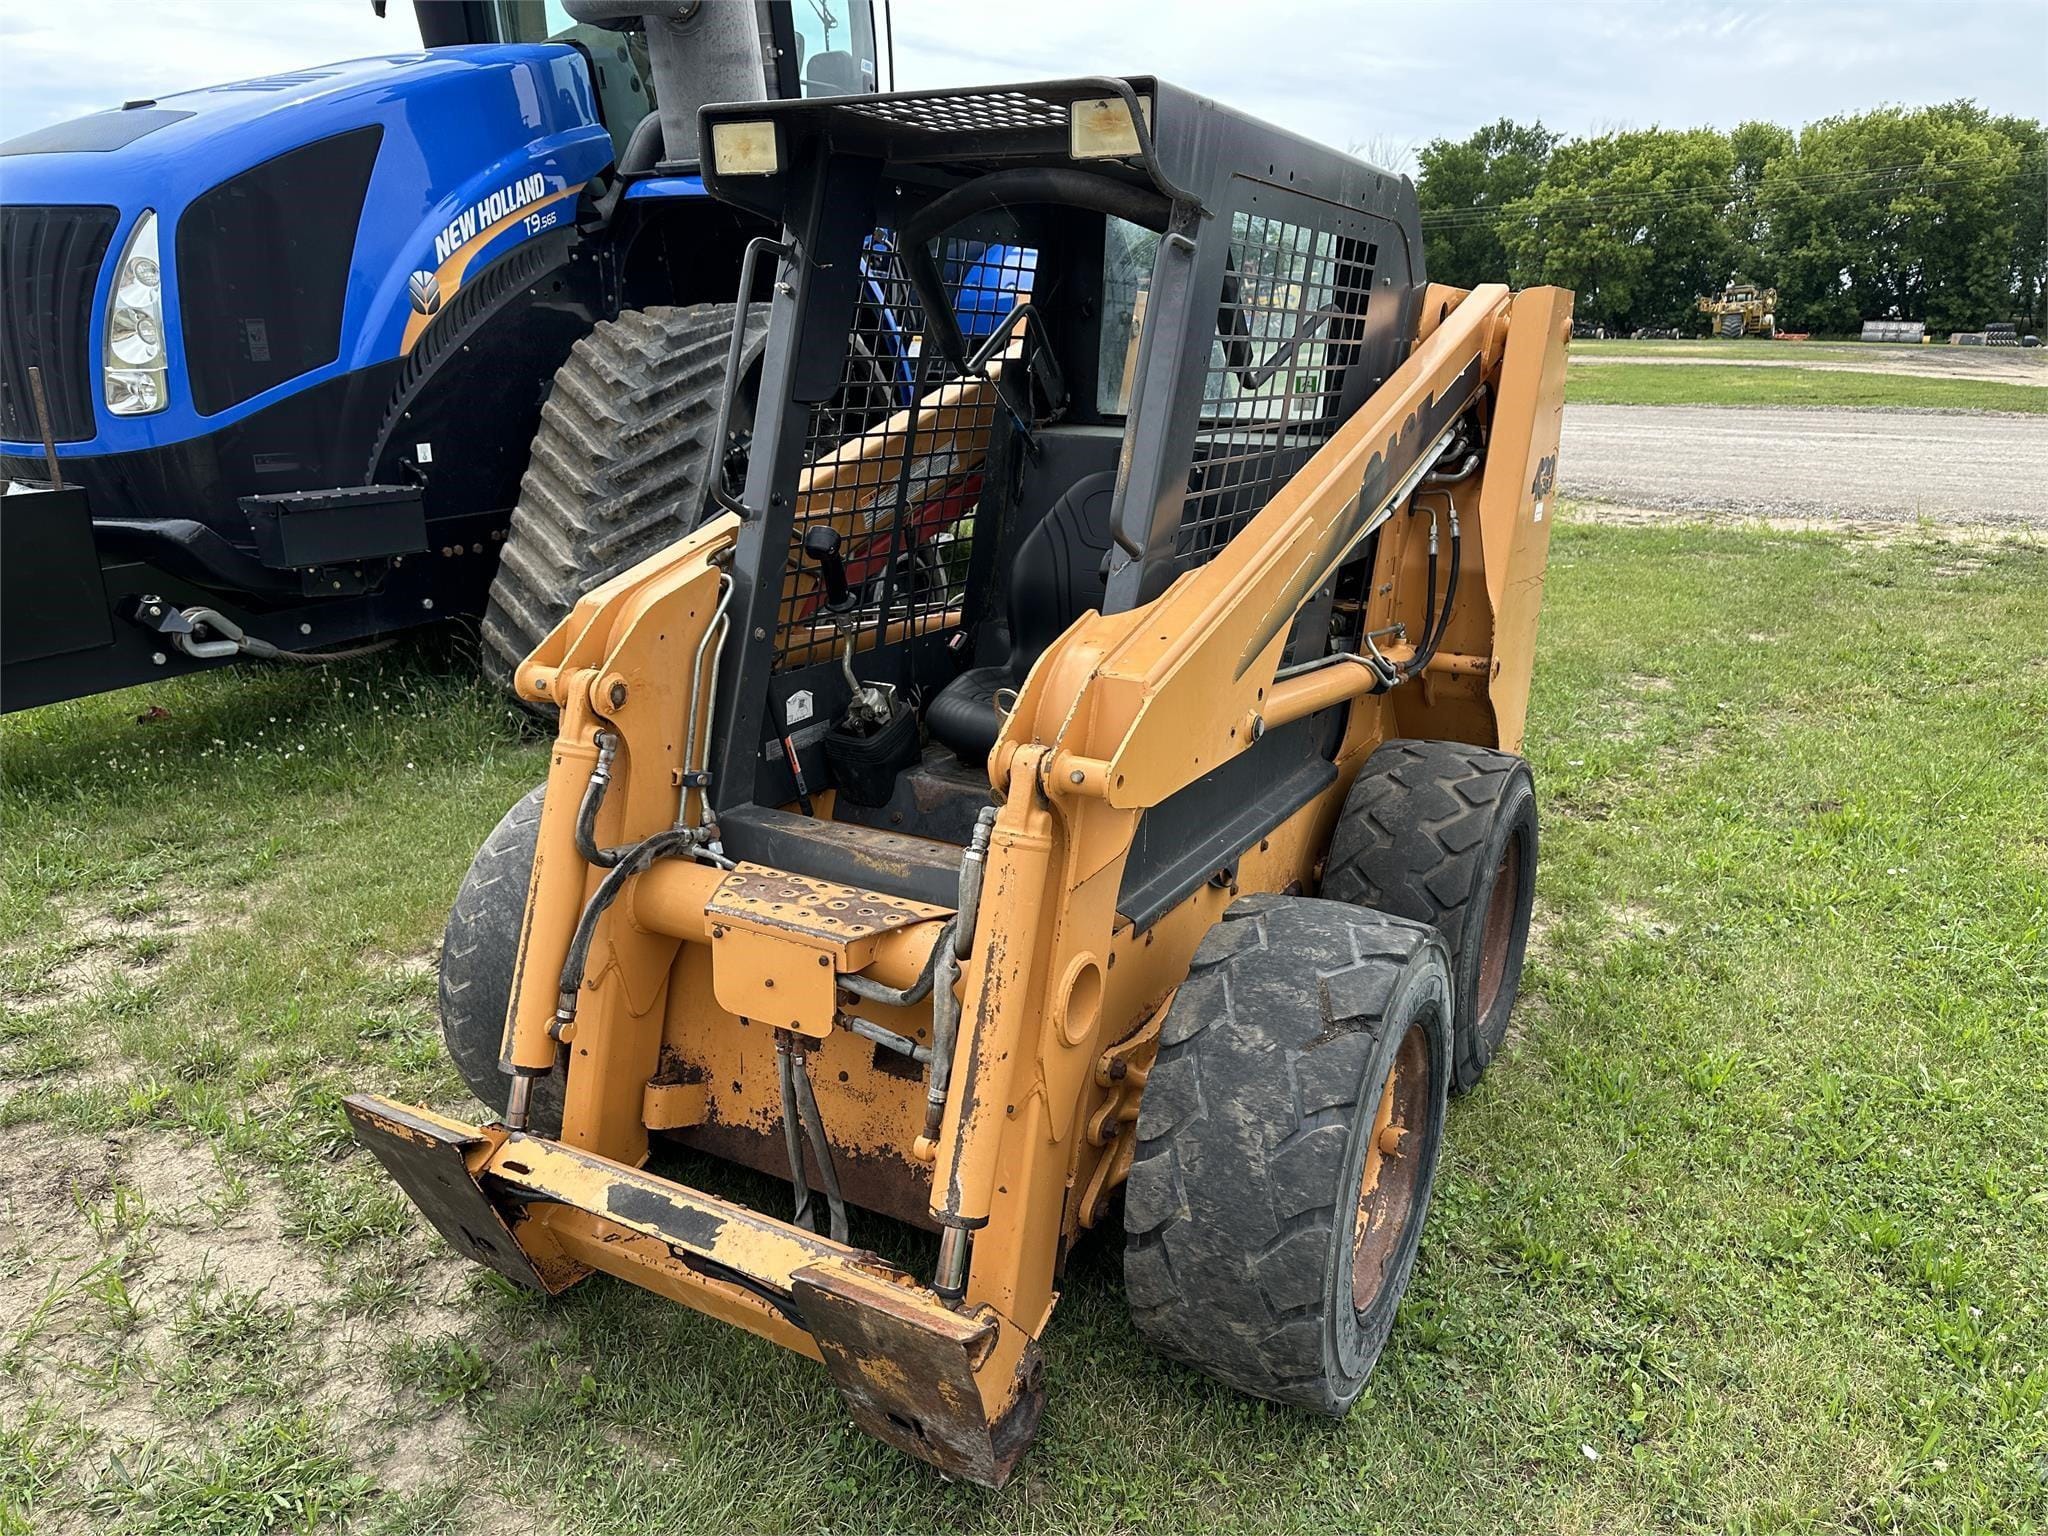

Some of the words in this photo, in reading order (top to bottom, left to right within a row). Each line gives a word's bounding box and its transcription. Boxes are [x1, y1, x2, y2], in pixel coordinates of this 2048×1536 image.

[434, 206, 476, 265] NEW
[477, 172, 545, 230] HOLLAND
[523, 211, 557, 236] T9.565
